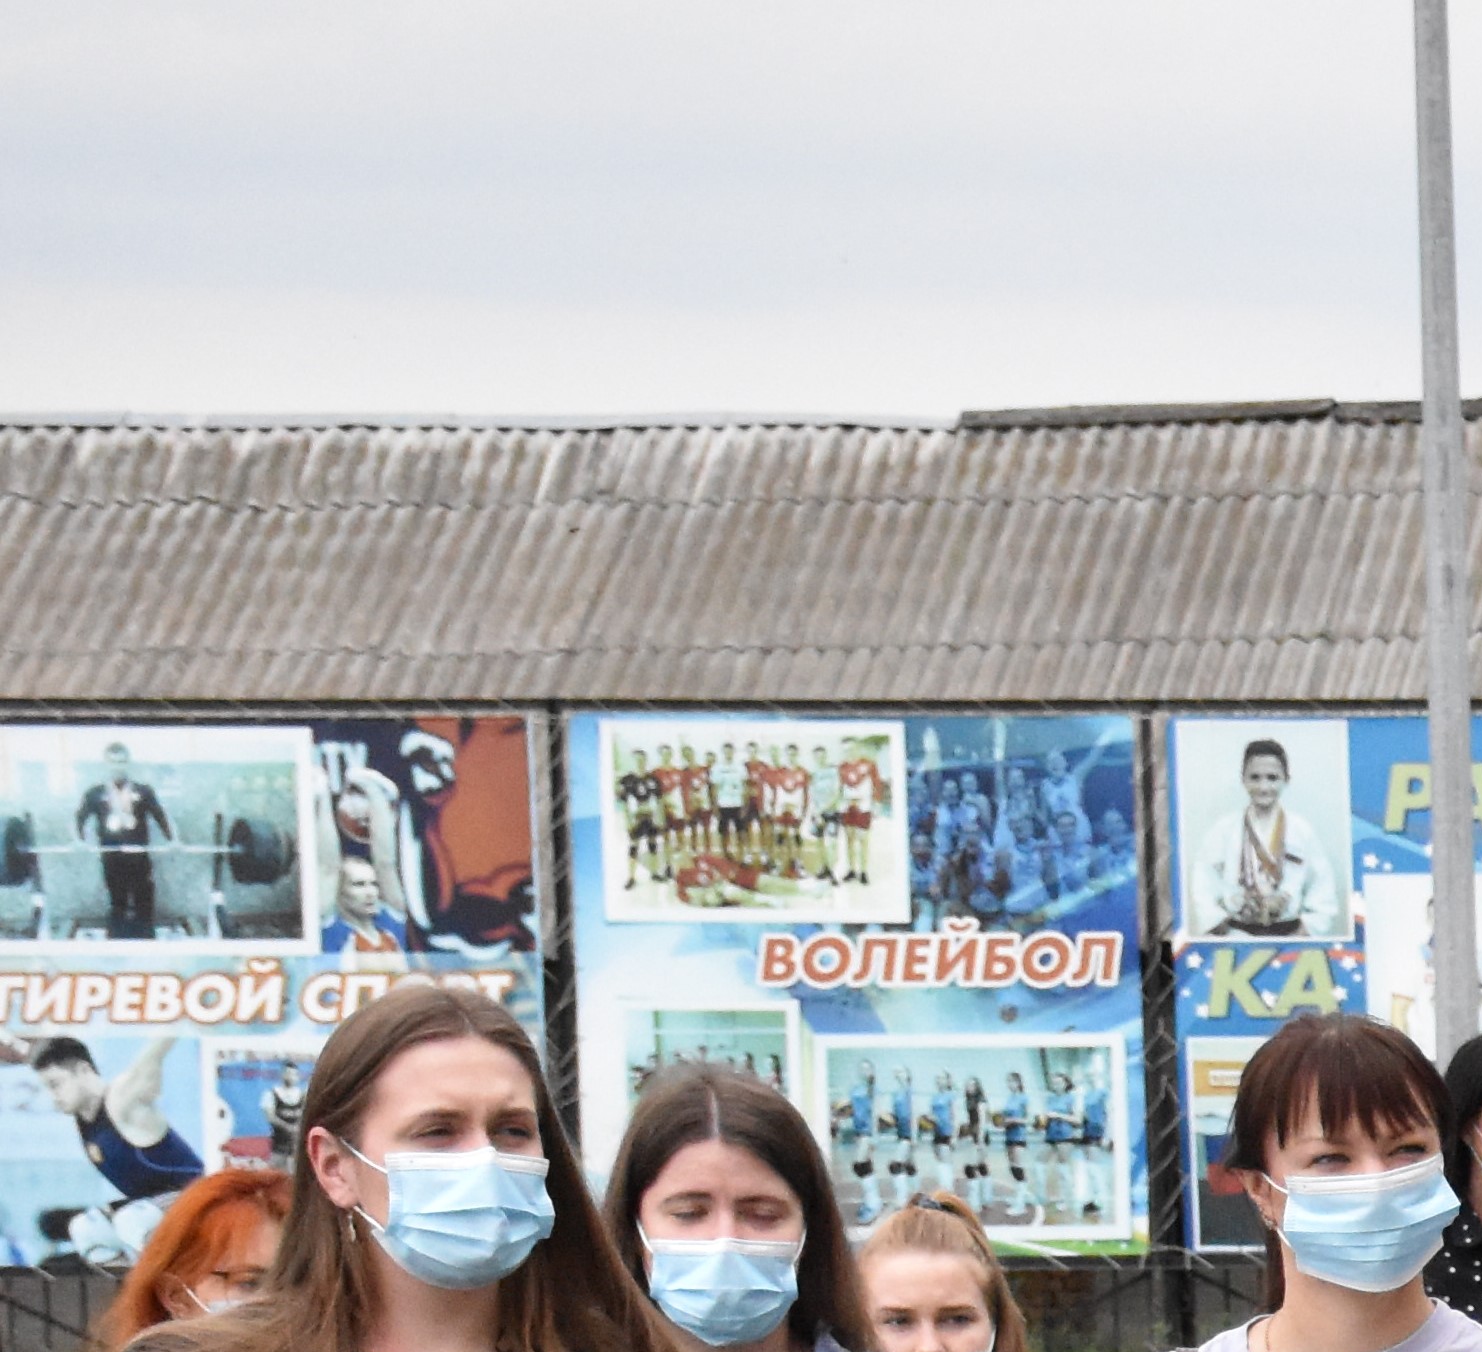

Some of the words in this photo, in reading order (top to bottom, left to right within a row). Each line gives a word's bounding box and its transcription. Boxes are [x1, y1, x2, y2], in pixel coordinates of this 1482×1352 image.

[758, 918, 1122, 987] ВОЛЕЙБОЛ
[1207, 947, 1343, 1019] КА
[300, 969, 515, 1023] СПТ
